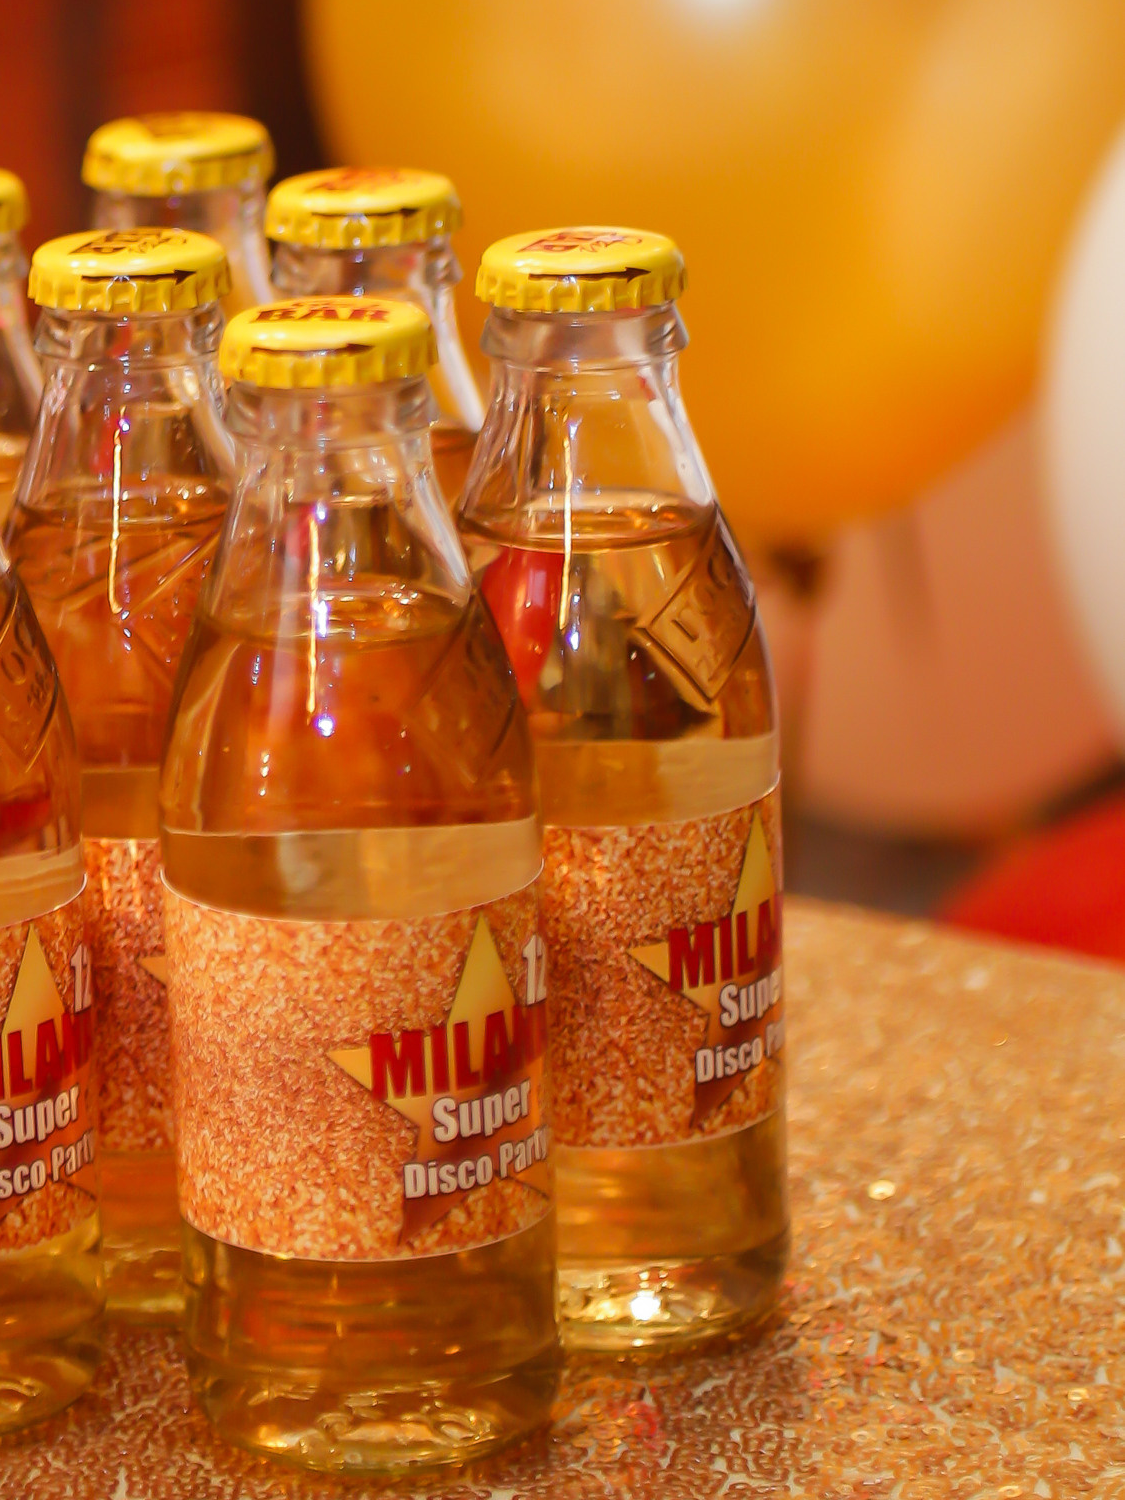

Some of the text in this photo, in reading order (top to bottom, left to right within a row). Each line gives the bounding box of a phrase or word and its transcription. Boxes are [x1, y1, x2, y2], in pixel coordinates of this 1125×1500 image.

[249, 306, 391, 323] BAR
[521, 934, 548, 1006] 12
[719, 963, 783, 1028] Supe
[694, 1035, 763, 1084] Disco
[431, 1077, 531, 1144] Super
[402, 1155, 494, 1200] Disco
